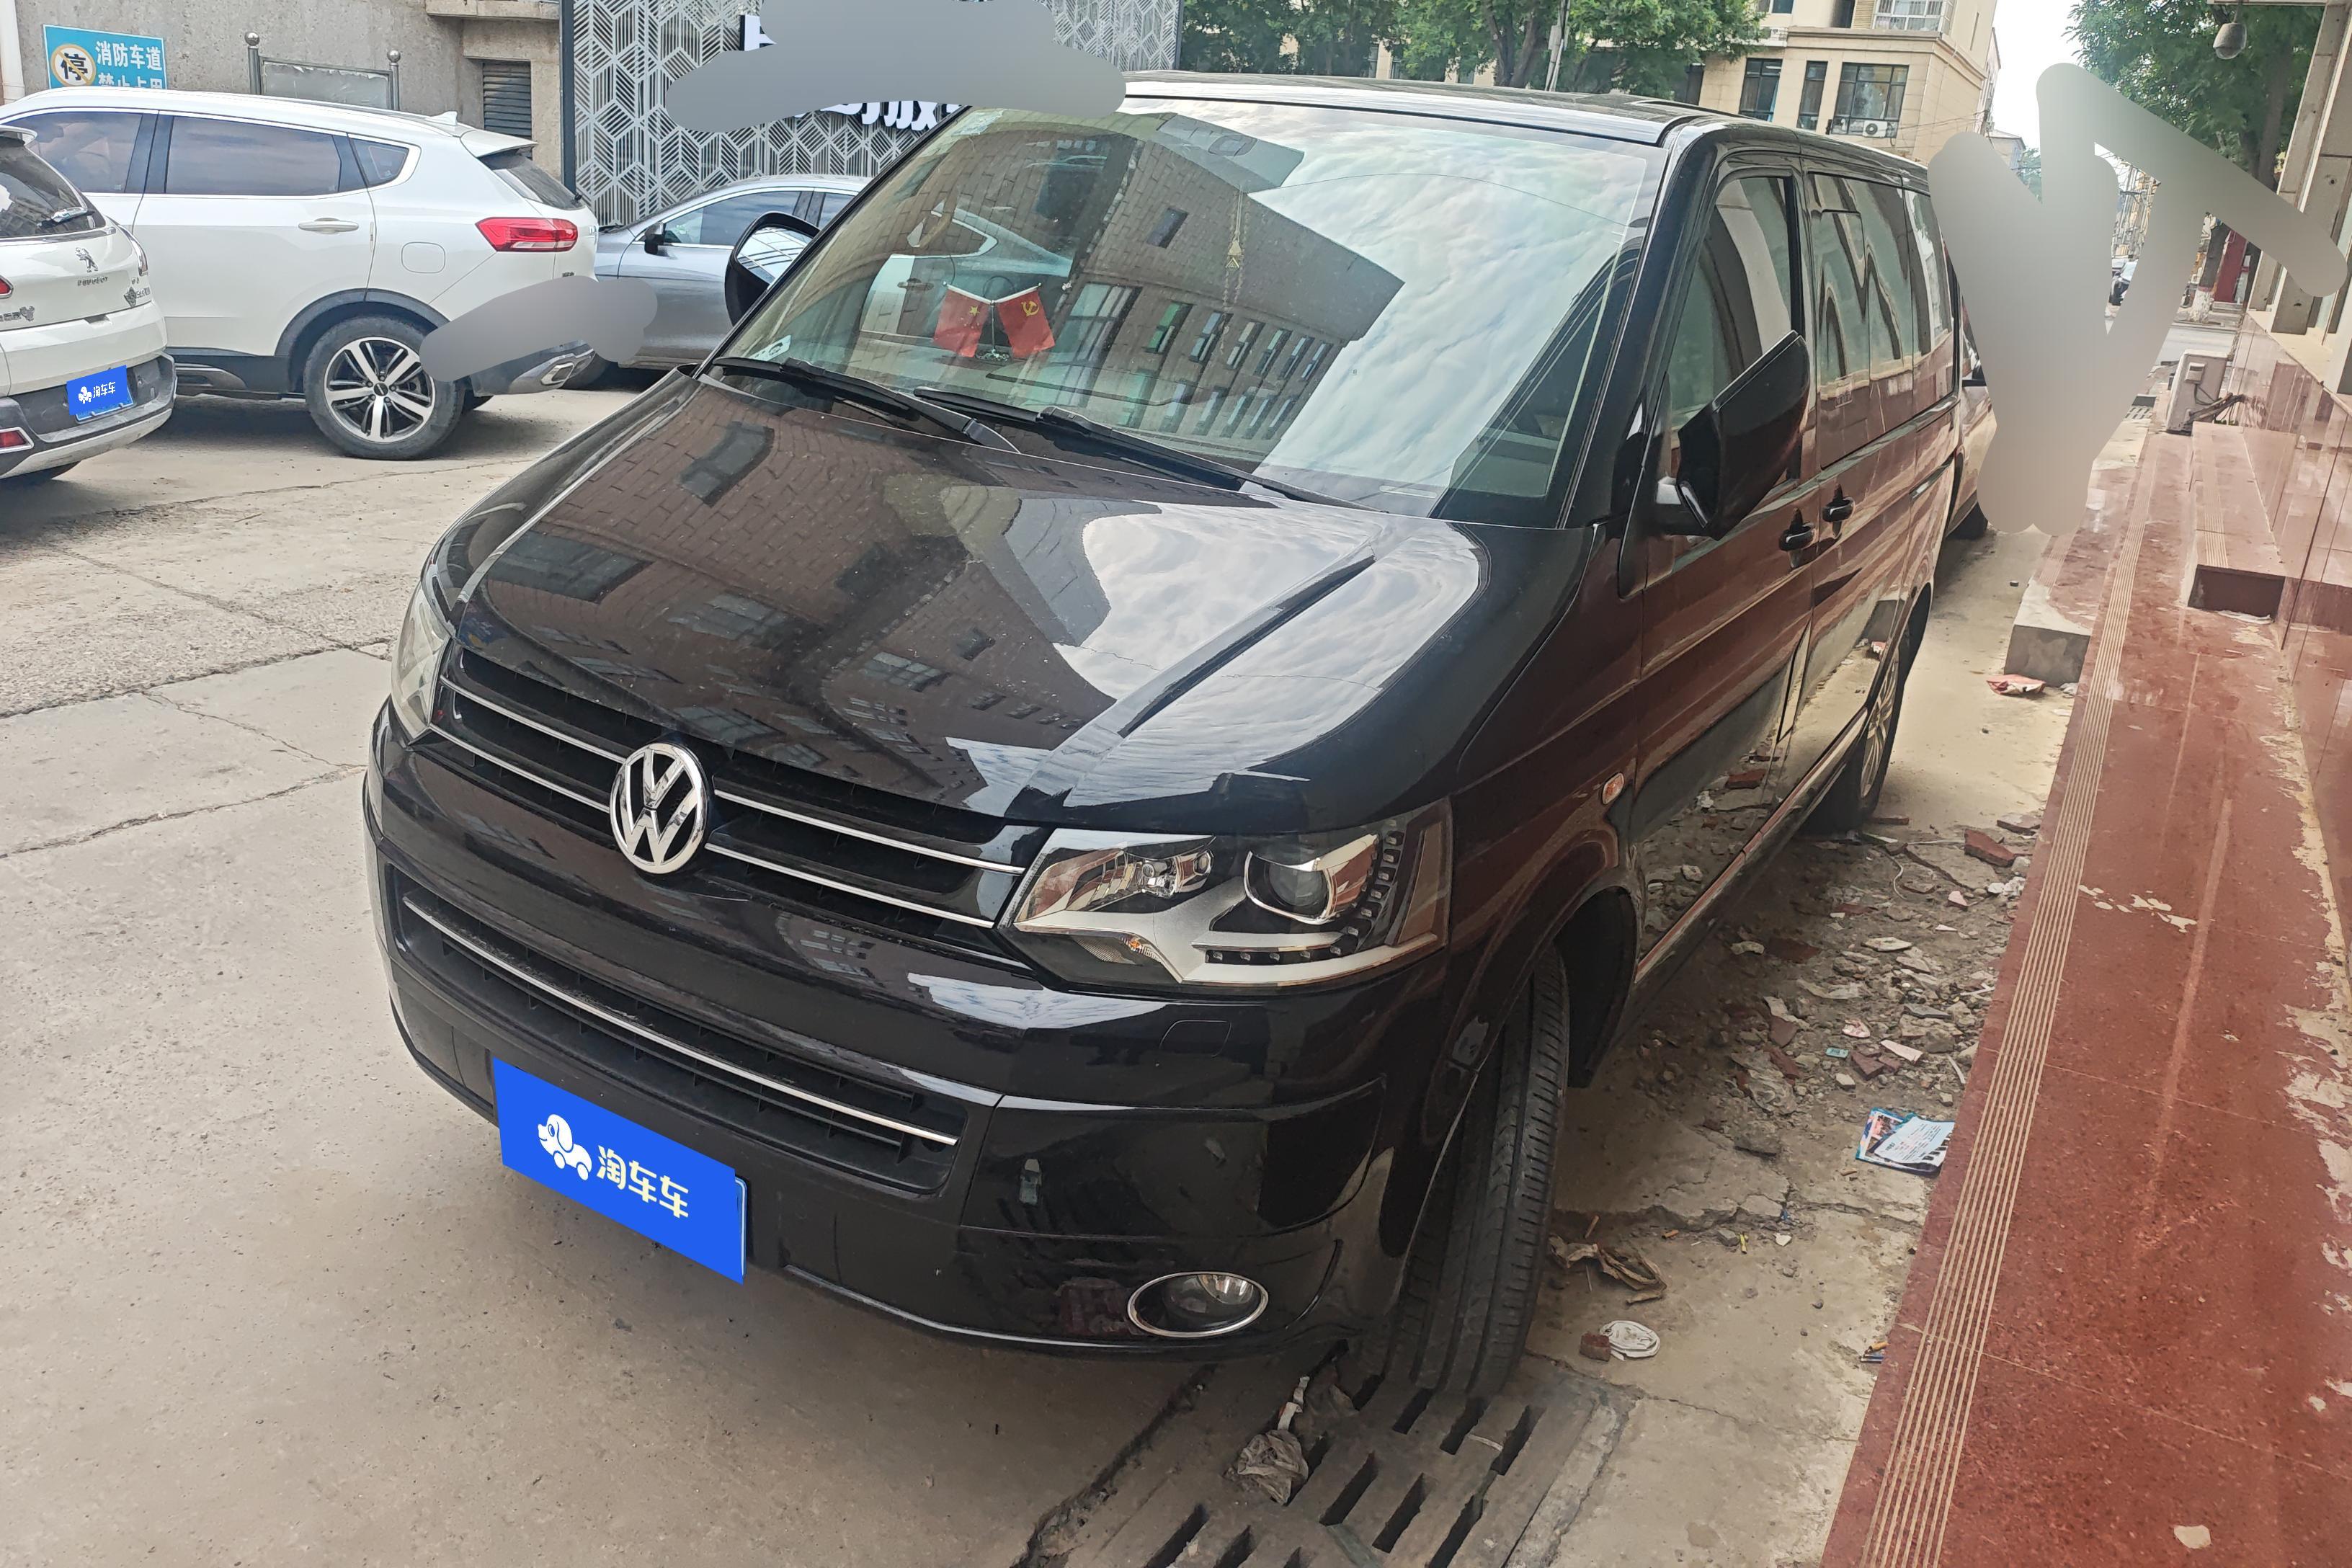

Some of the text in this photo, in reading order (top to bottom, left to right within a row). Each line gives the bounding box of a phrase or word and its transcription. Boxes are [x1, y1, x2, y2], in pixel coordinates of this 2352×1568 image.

[61, 53, 88, 81] 停
[95, 40, 162, 71] 消防车道
